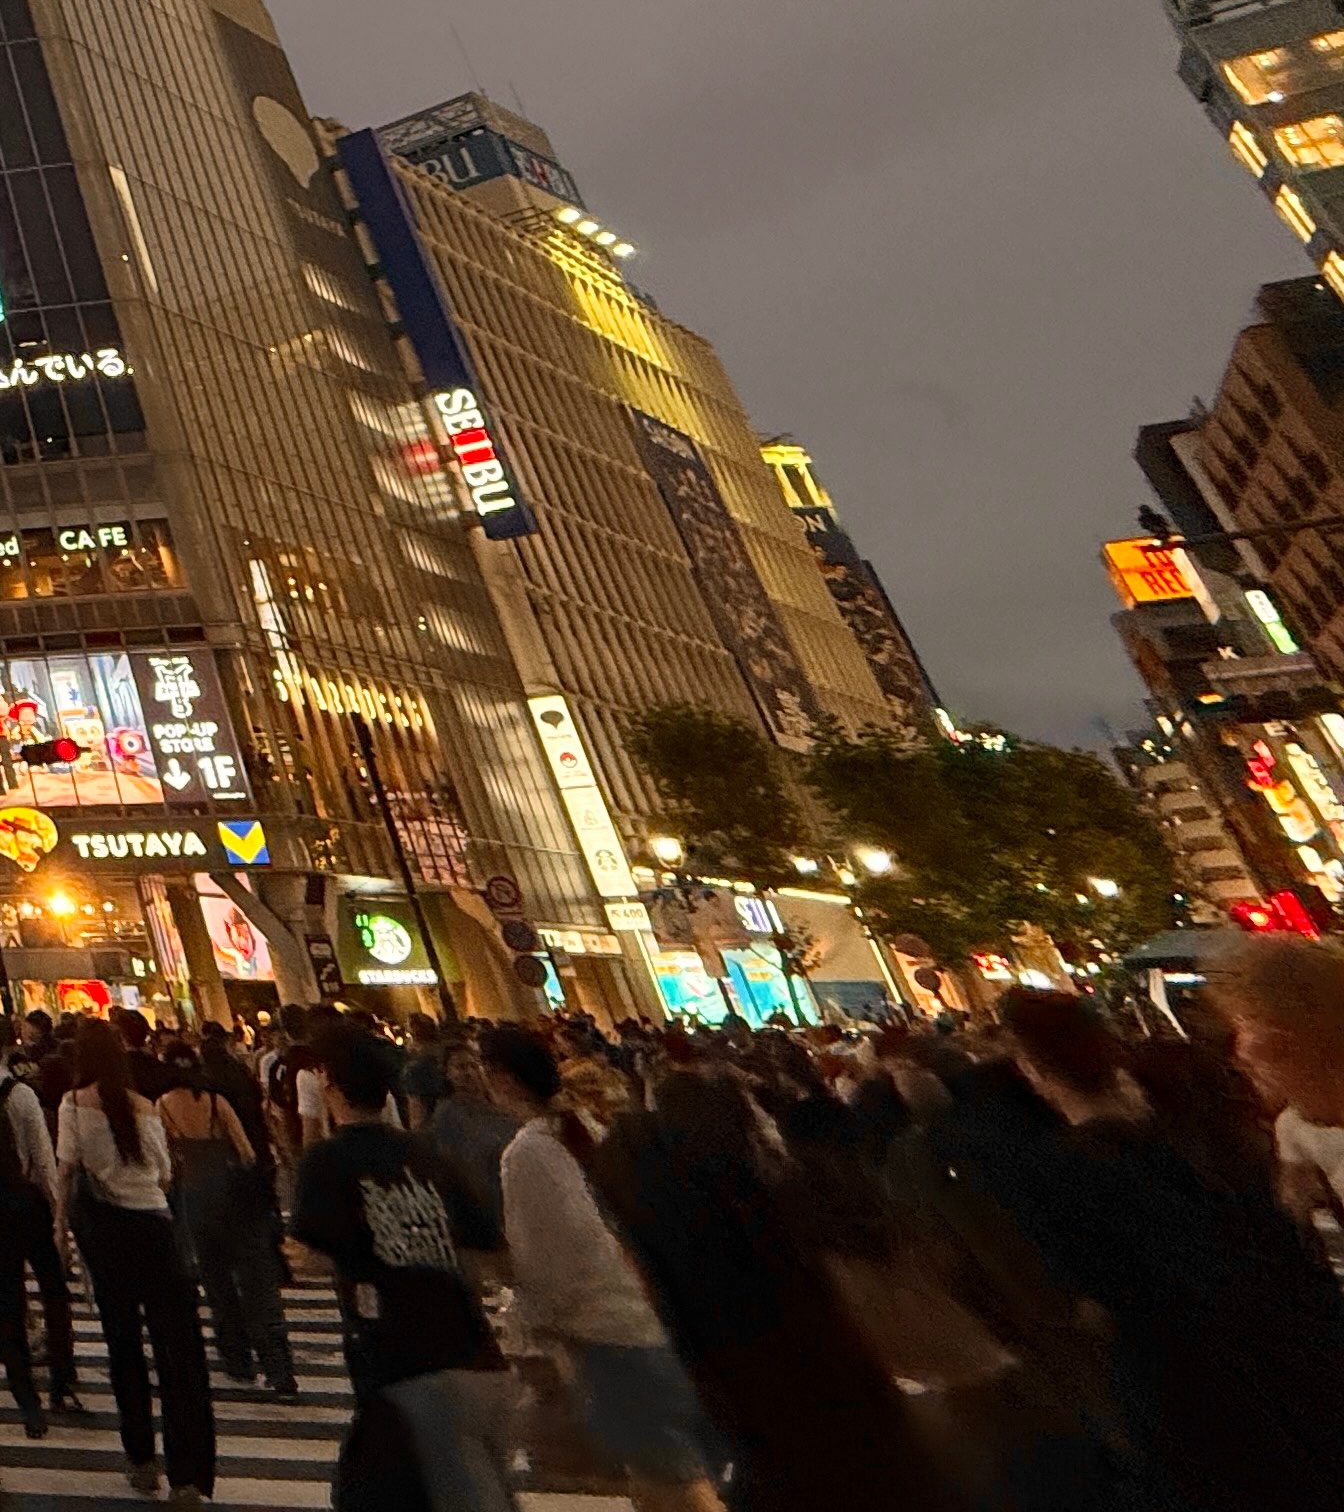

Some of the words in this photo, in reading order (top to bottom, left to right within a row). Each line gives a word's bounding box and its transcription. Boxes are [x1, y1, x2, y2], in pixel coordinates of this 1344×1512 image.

[434, 387, 517, 517] SEIBU
[58, 525, 128, 553] CAFE
[197, 755, 237, 789] 1F
[71, 830, 210, 860] TSUTAYA
